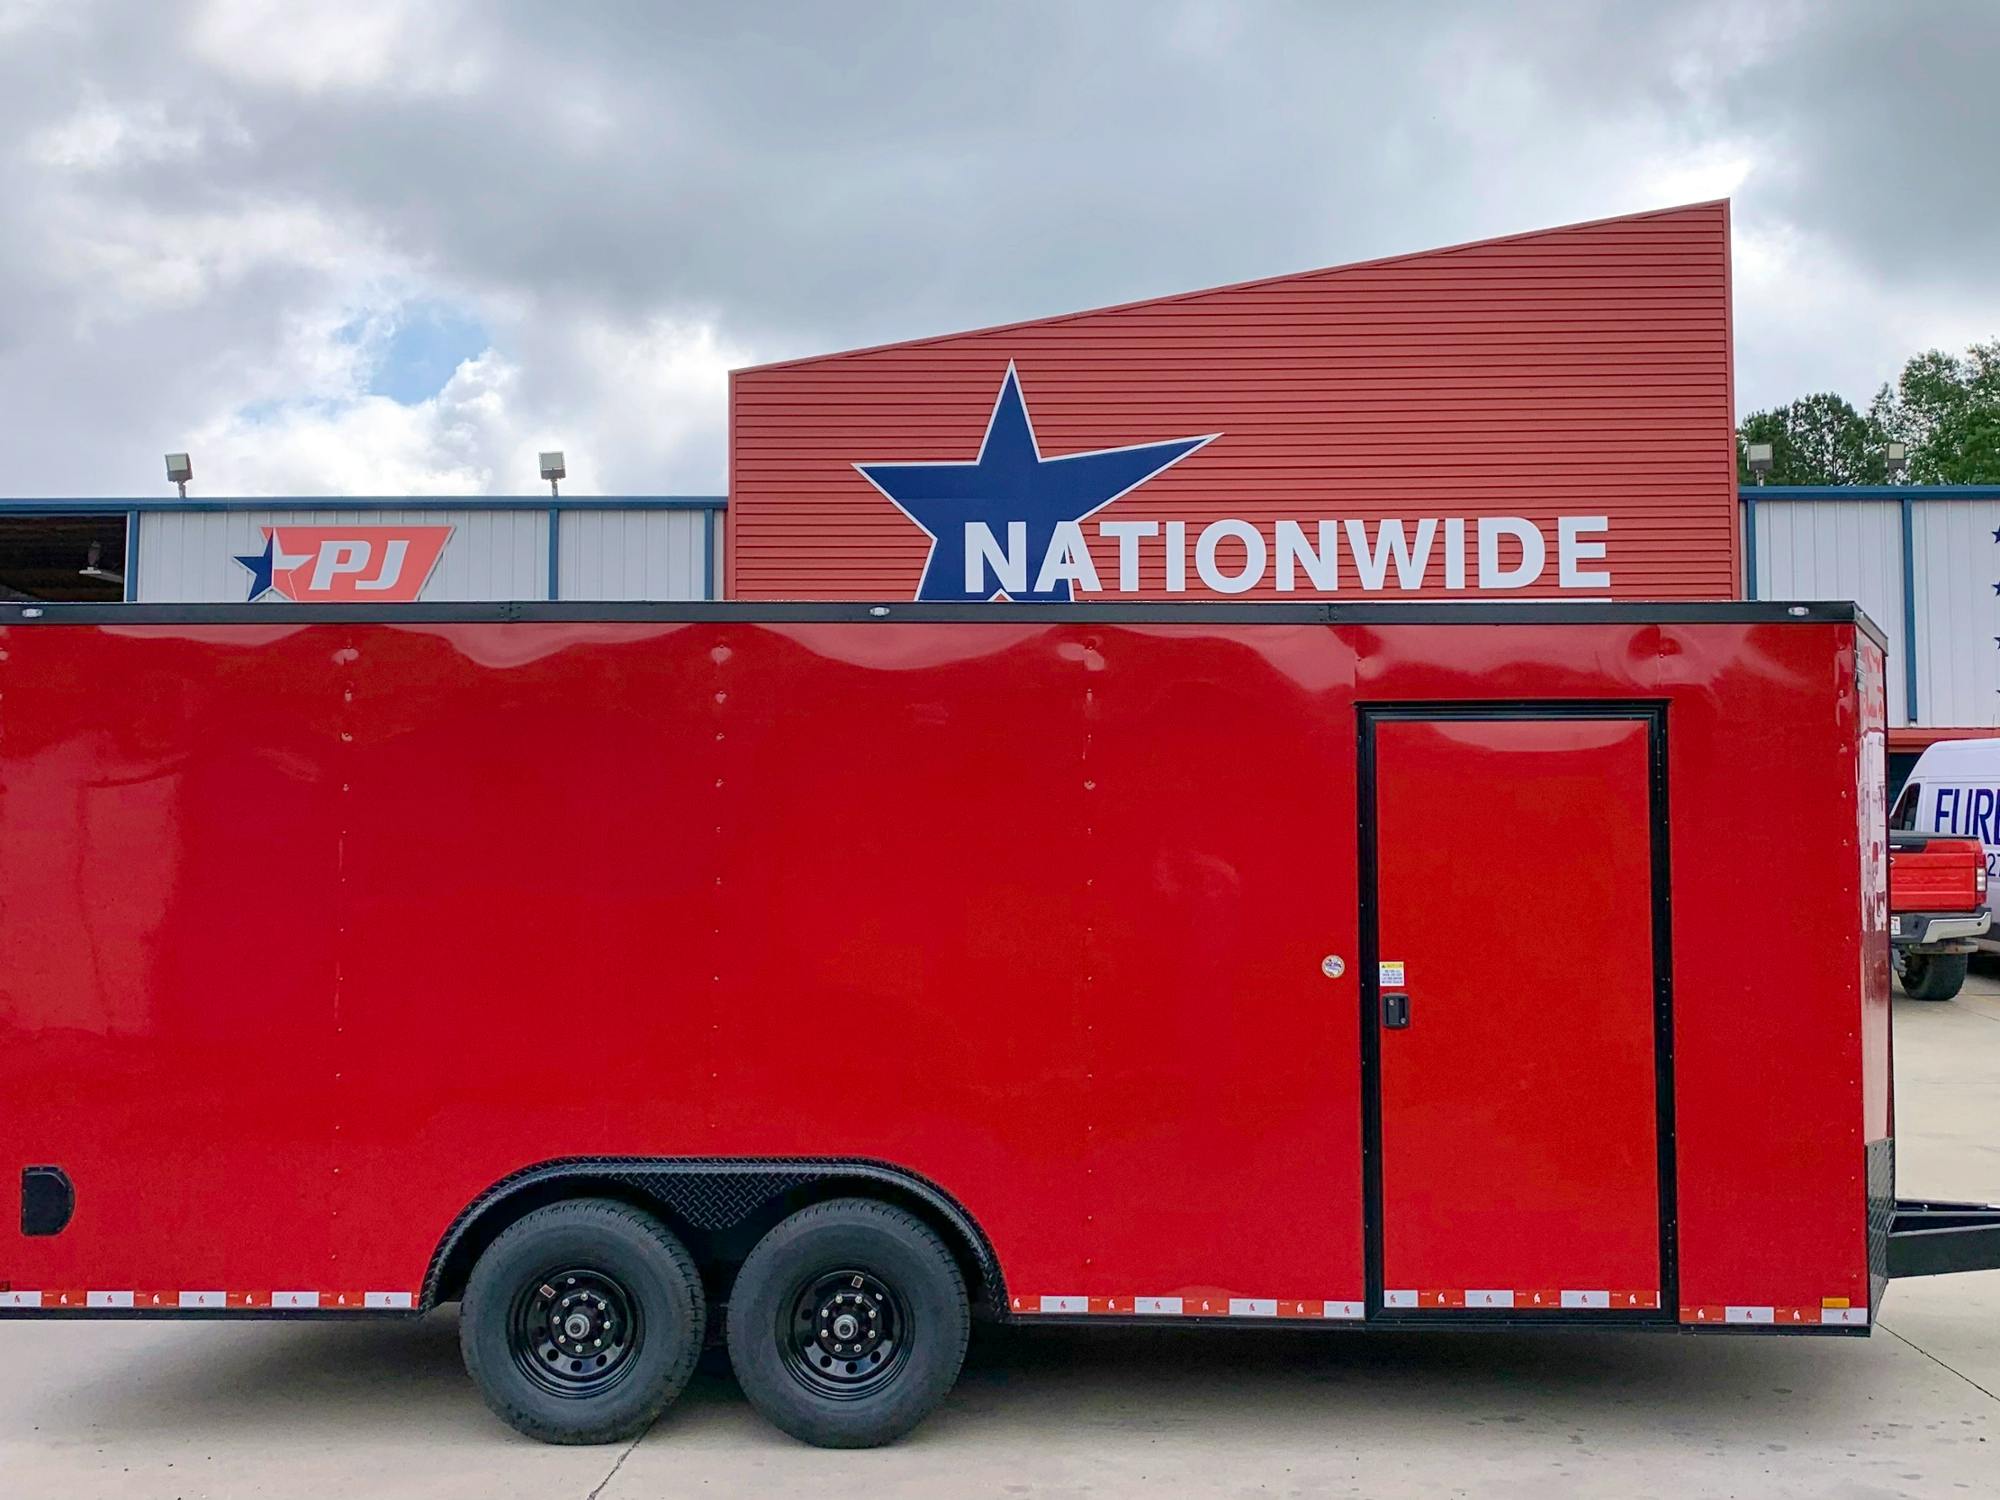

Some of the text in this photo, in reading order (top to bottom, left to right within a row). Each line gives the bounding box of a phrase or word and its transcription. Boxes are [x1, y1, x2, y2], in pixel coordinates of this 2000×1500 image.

[308, 540, 410, 590] PJ
[964, 516, 1611, 592] NATIONWIDE
[1934, 788, 2000, 845] FUR
